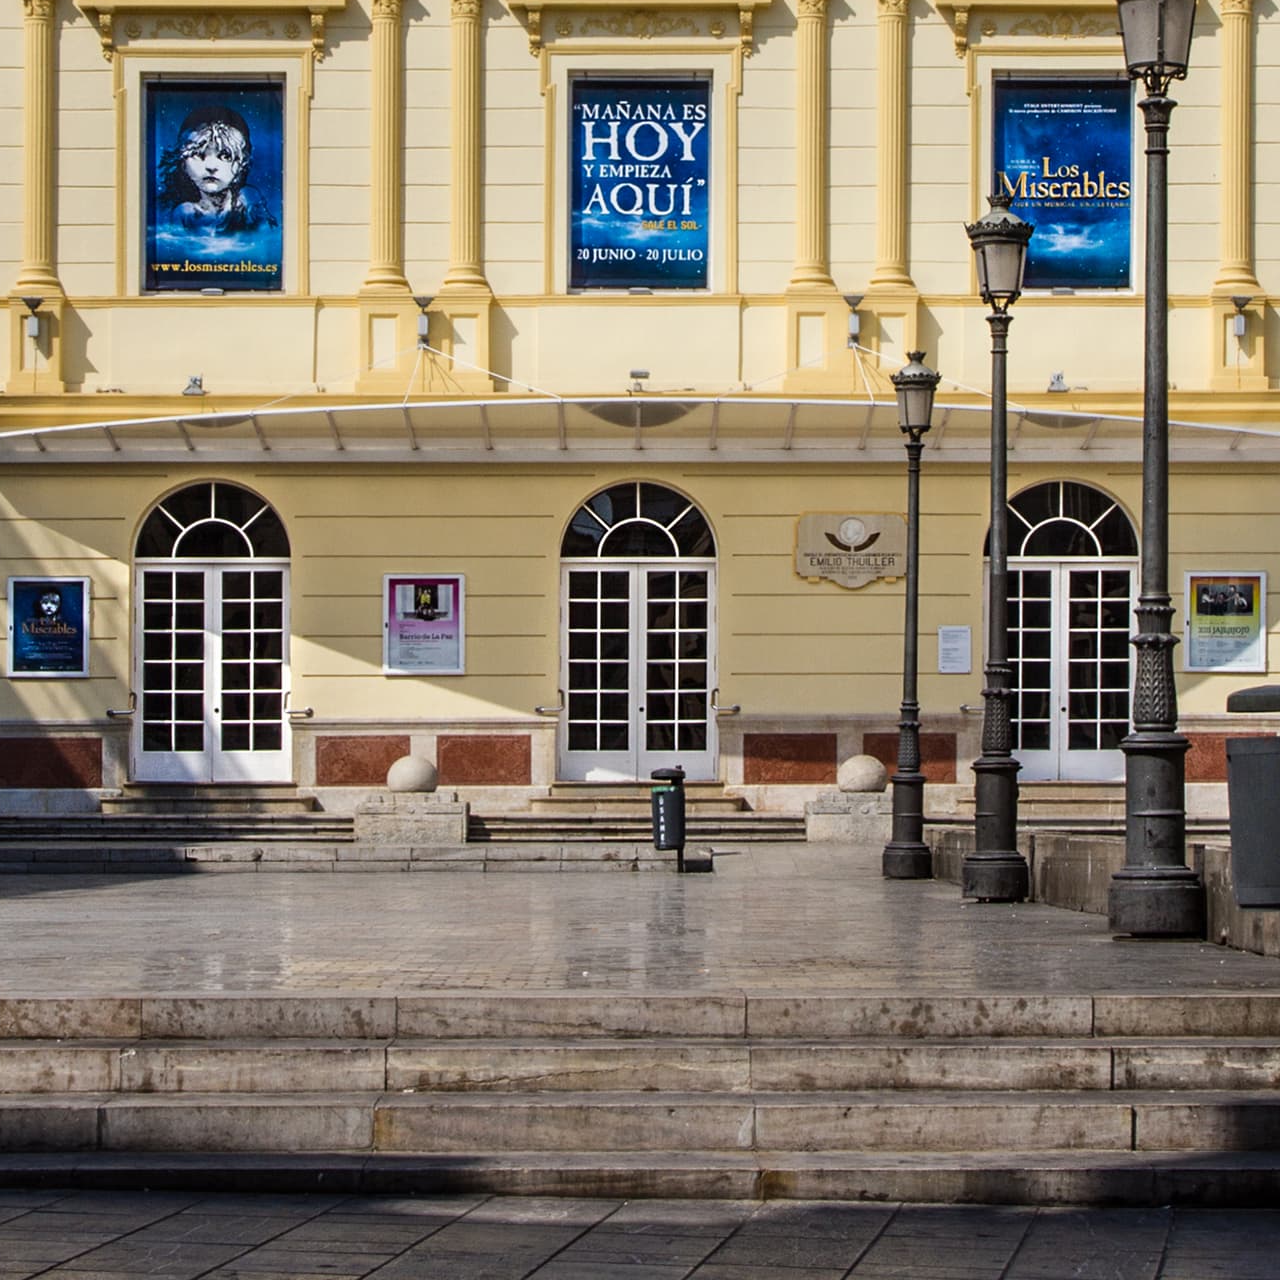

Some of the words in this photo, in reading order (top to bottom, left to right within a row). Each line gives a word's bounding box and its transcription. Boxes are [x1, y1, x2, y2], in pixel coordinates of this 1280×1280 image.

[683, 104, 706, 120] ES
[582, 121, 705, 161] HOY
[583, 165, 595, 178] Y
[599, 165, 672, 178] EMPIEZA
[1042, 157, 1079, 178] Los
[997, 171, 1131, 198] Miserables
[577, 249, 589, 260] 20
[592, 249, 636, 263] JUNIO
[646, 249, 659, 260] 20
[662, 249, 703, 263] JULIO
[151, 260, 278, 272] www.losmiserables.es
[810, 557, 842, 566] EMILIO
[847, 557, 895, 567] THUILLER
